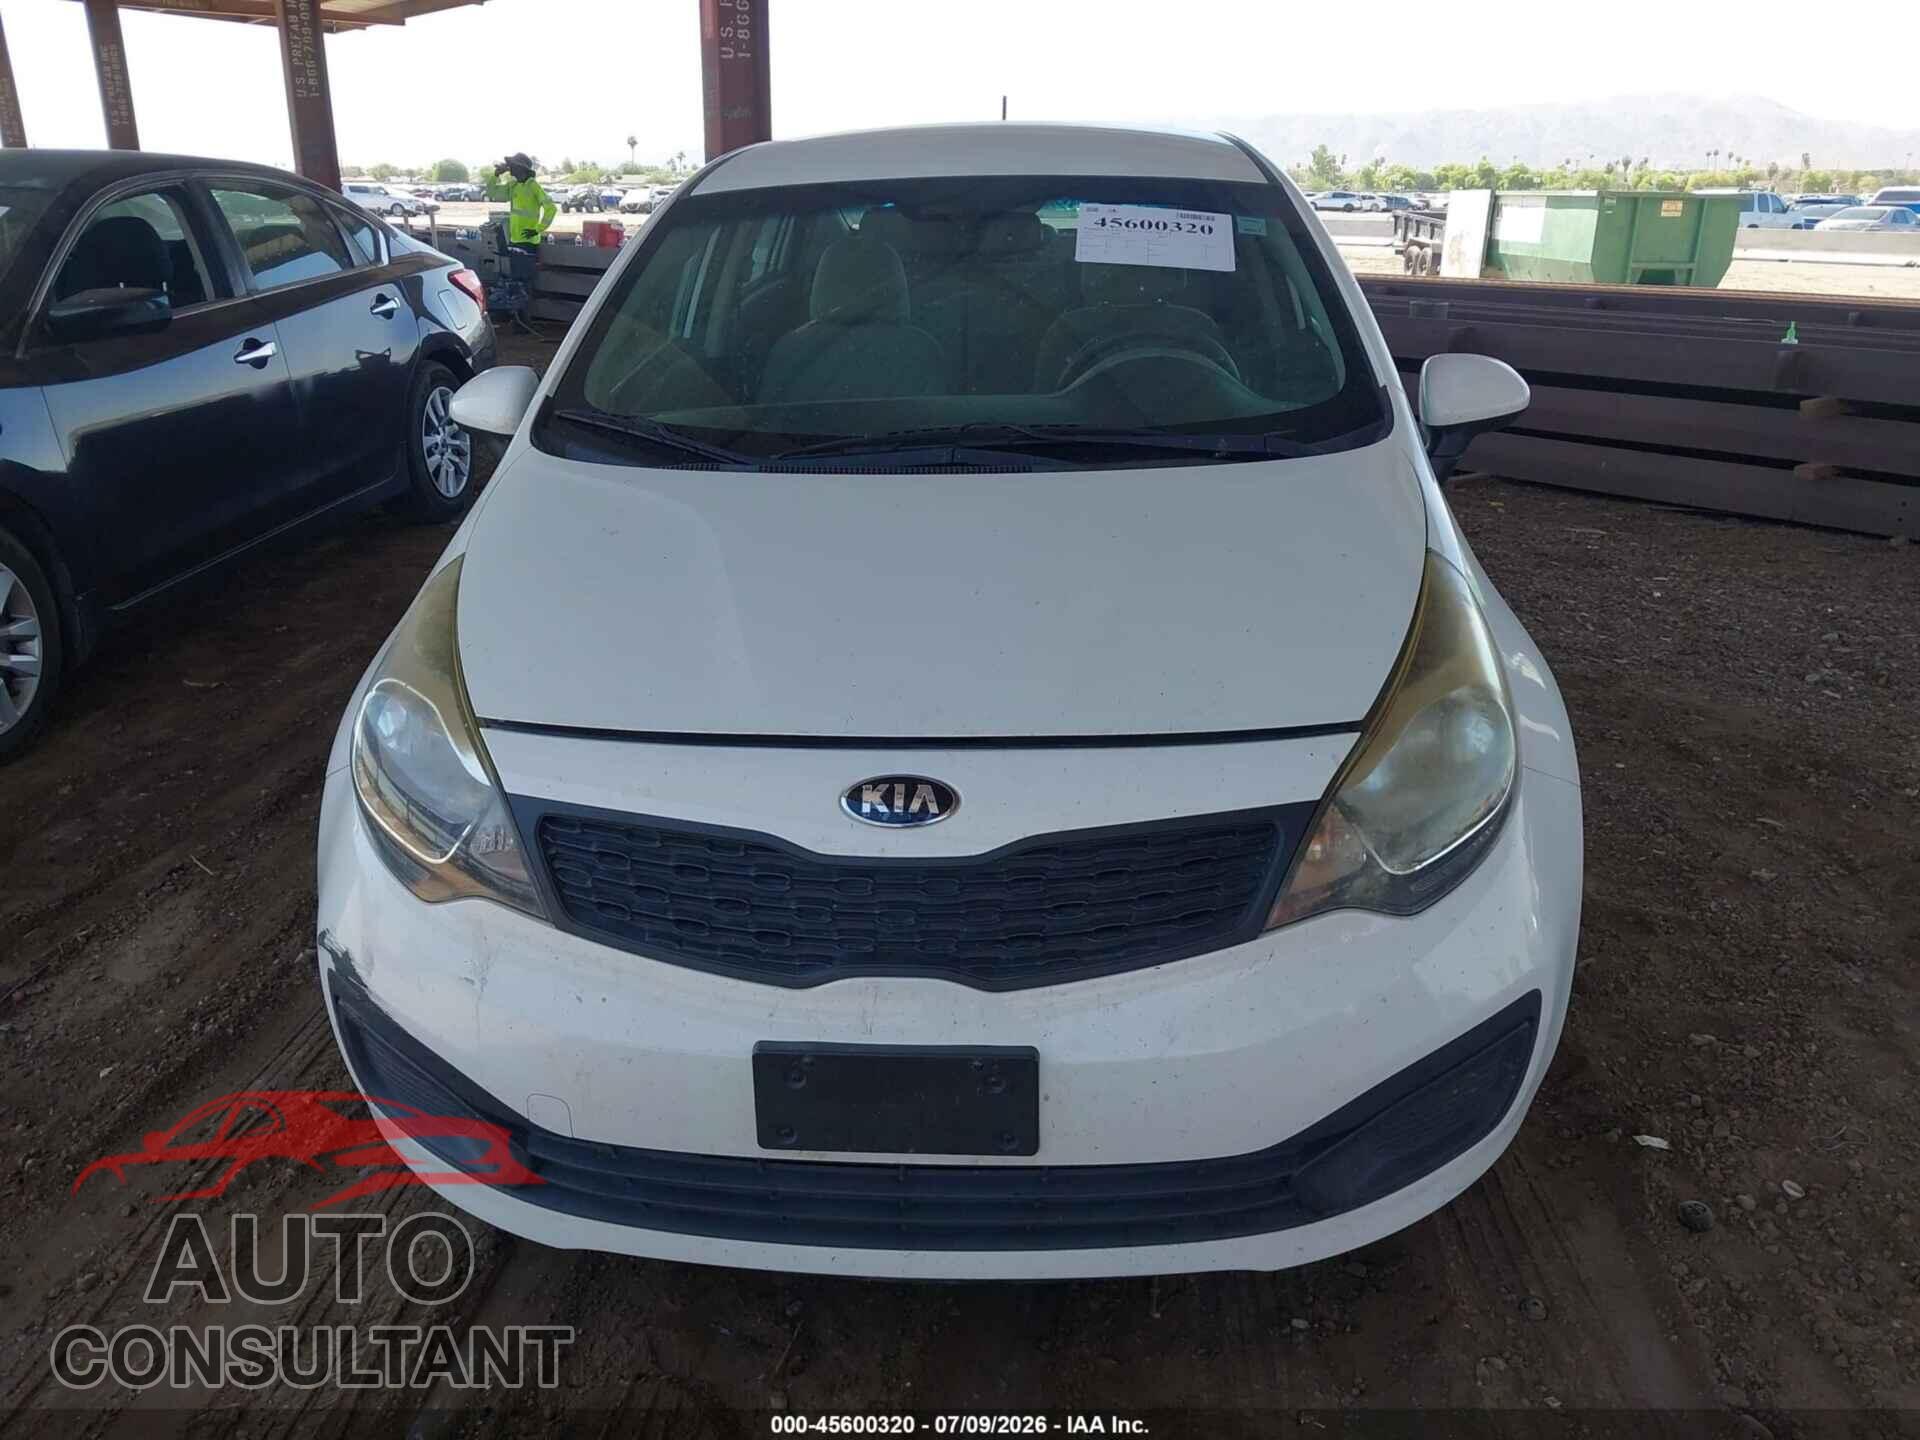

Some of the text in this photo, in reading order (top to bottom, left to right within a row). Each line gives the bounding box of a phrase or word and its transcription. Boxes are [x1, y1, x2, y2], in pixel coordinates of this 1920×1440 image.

[720, 20, 734, 58] U.S.
[1094, 216, 1214, 236] 45600320
[862, 783, 940, 814] KIA
